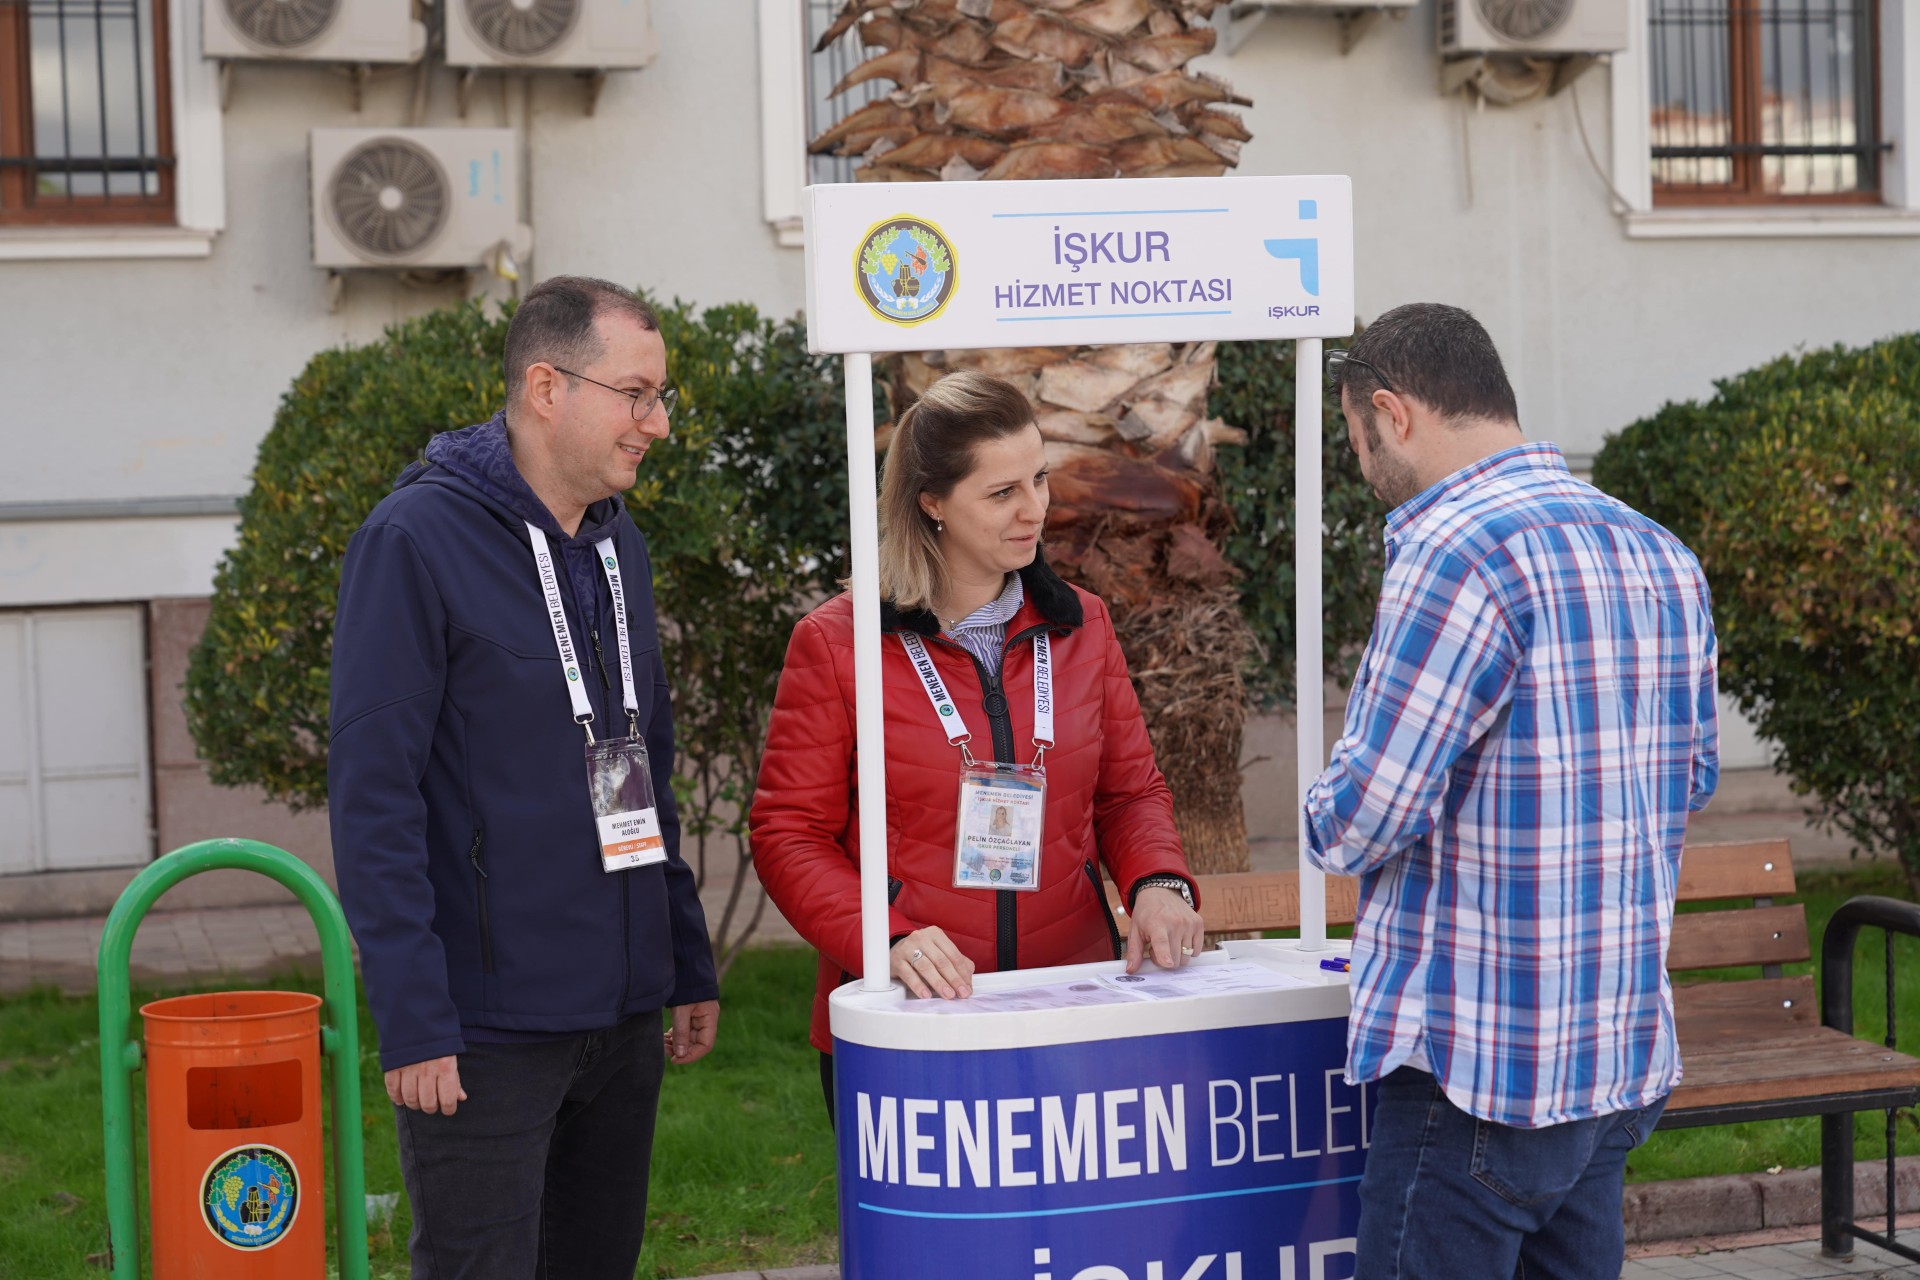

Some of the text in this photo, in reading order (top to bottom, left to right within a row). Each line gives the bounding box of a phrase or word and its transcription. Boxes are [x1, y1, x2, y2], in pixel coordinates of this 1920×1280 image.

[1054, 226, 1170, 273] İŞKUR
[995, 278, 1232, 308] HİZMET NOKTASI
[609, 574, 625, 624] MENEMEN
[552, 610, 574, 663] MENEMEN
[917, 659, 947, 702] MENEMEN
[630, 854, 640, 863] 35
[967, 835, 1031, 846] PELİN ÖZÇAĞLAYAN
[857, 1083, 1187, 1189] MENEMEN
